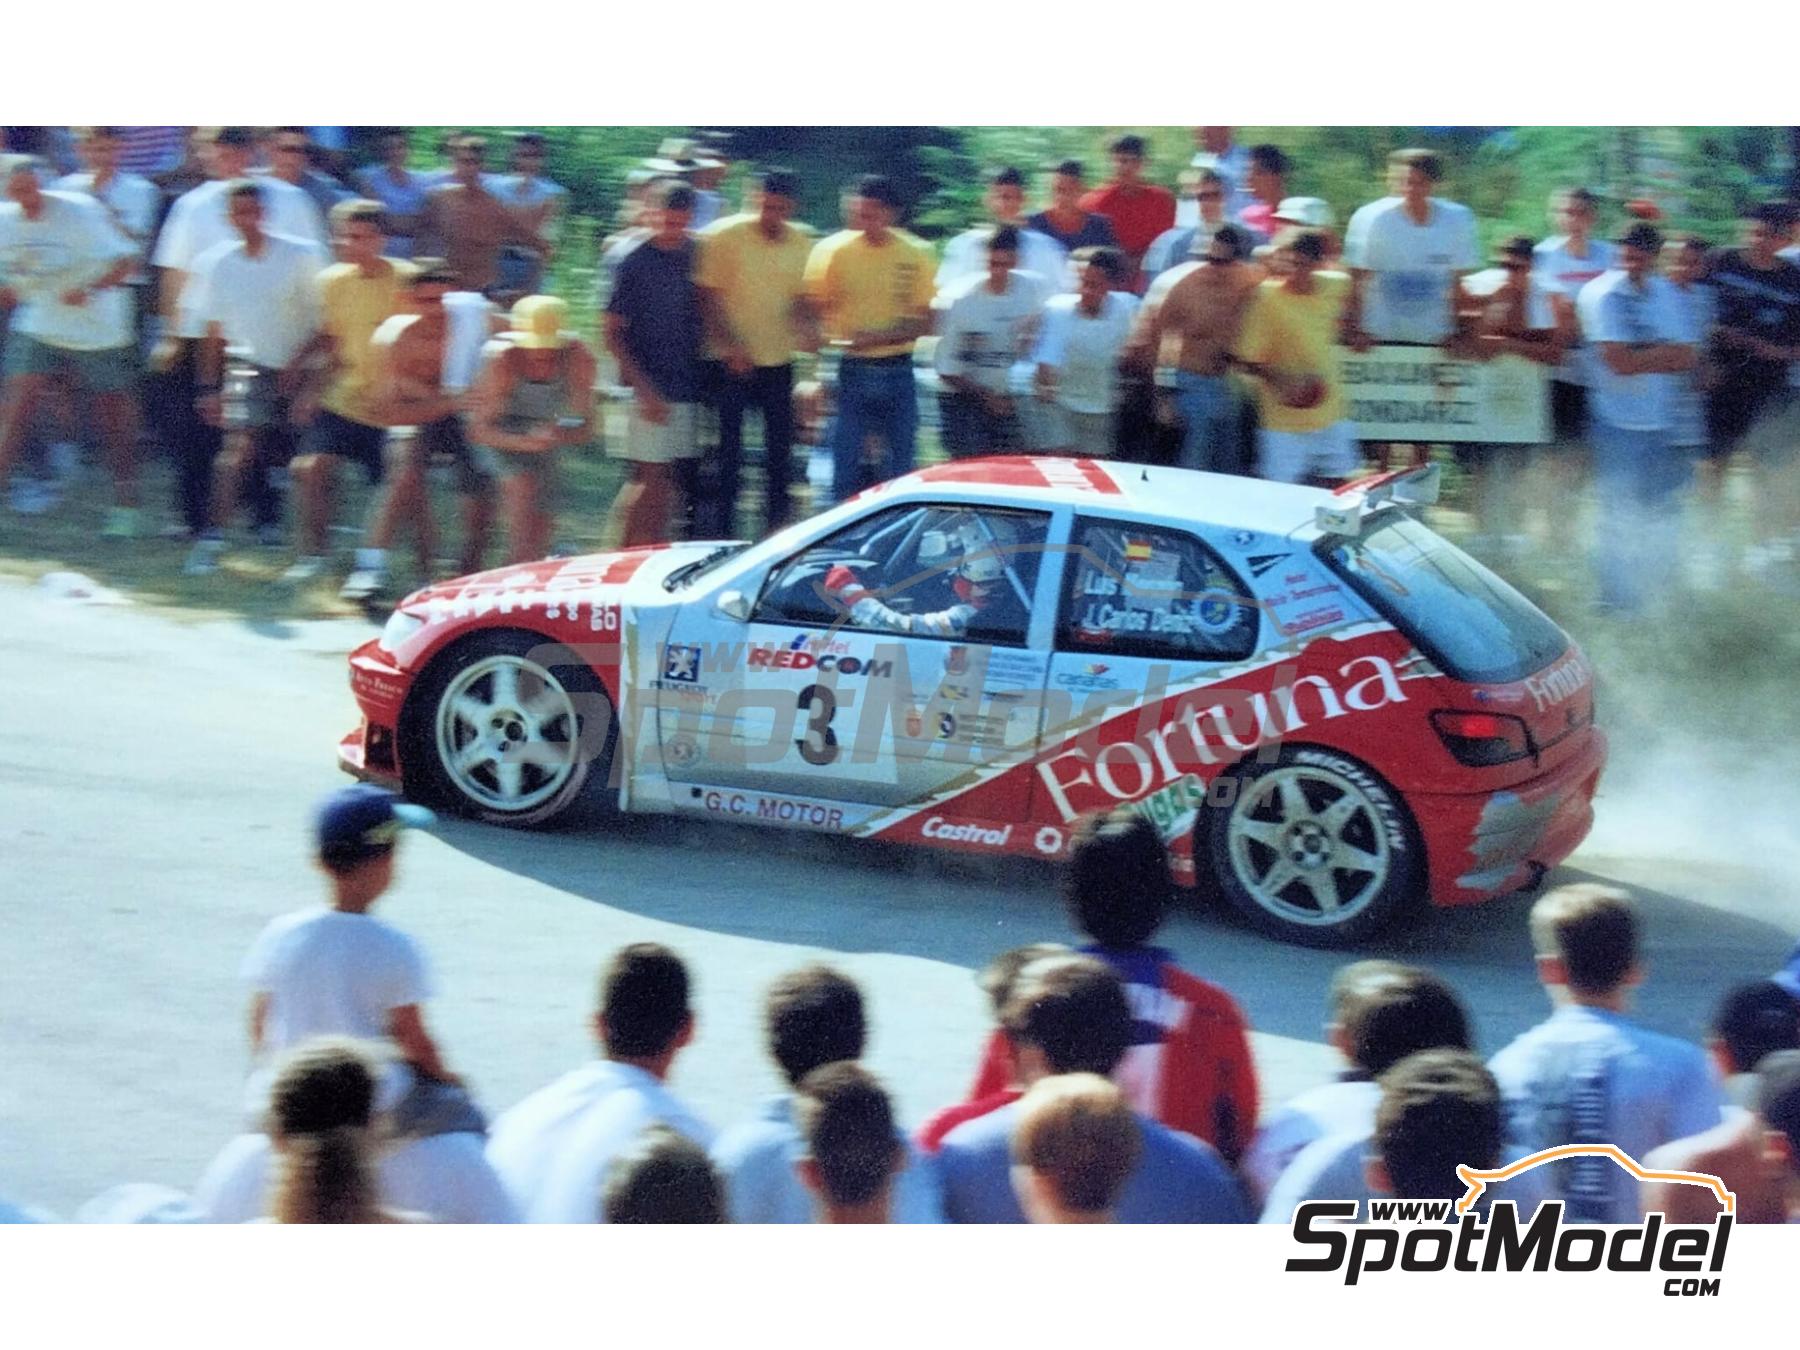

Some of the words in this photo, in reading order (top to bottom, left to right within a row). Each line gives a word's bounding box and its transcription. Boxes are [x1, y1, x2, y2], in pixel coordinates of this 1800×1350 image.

[748, 648, 892, 678] REDCOM
[796, 684, 838, 765] 3
[1036, 655, 1409, 823] Fortuna
[705, 792, 750, 814] G.C.
[757, 798, 843, 830] MOTOR
[921, 816, 1013, 846] Castrol
